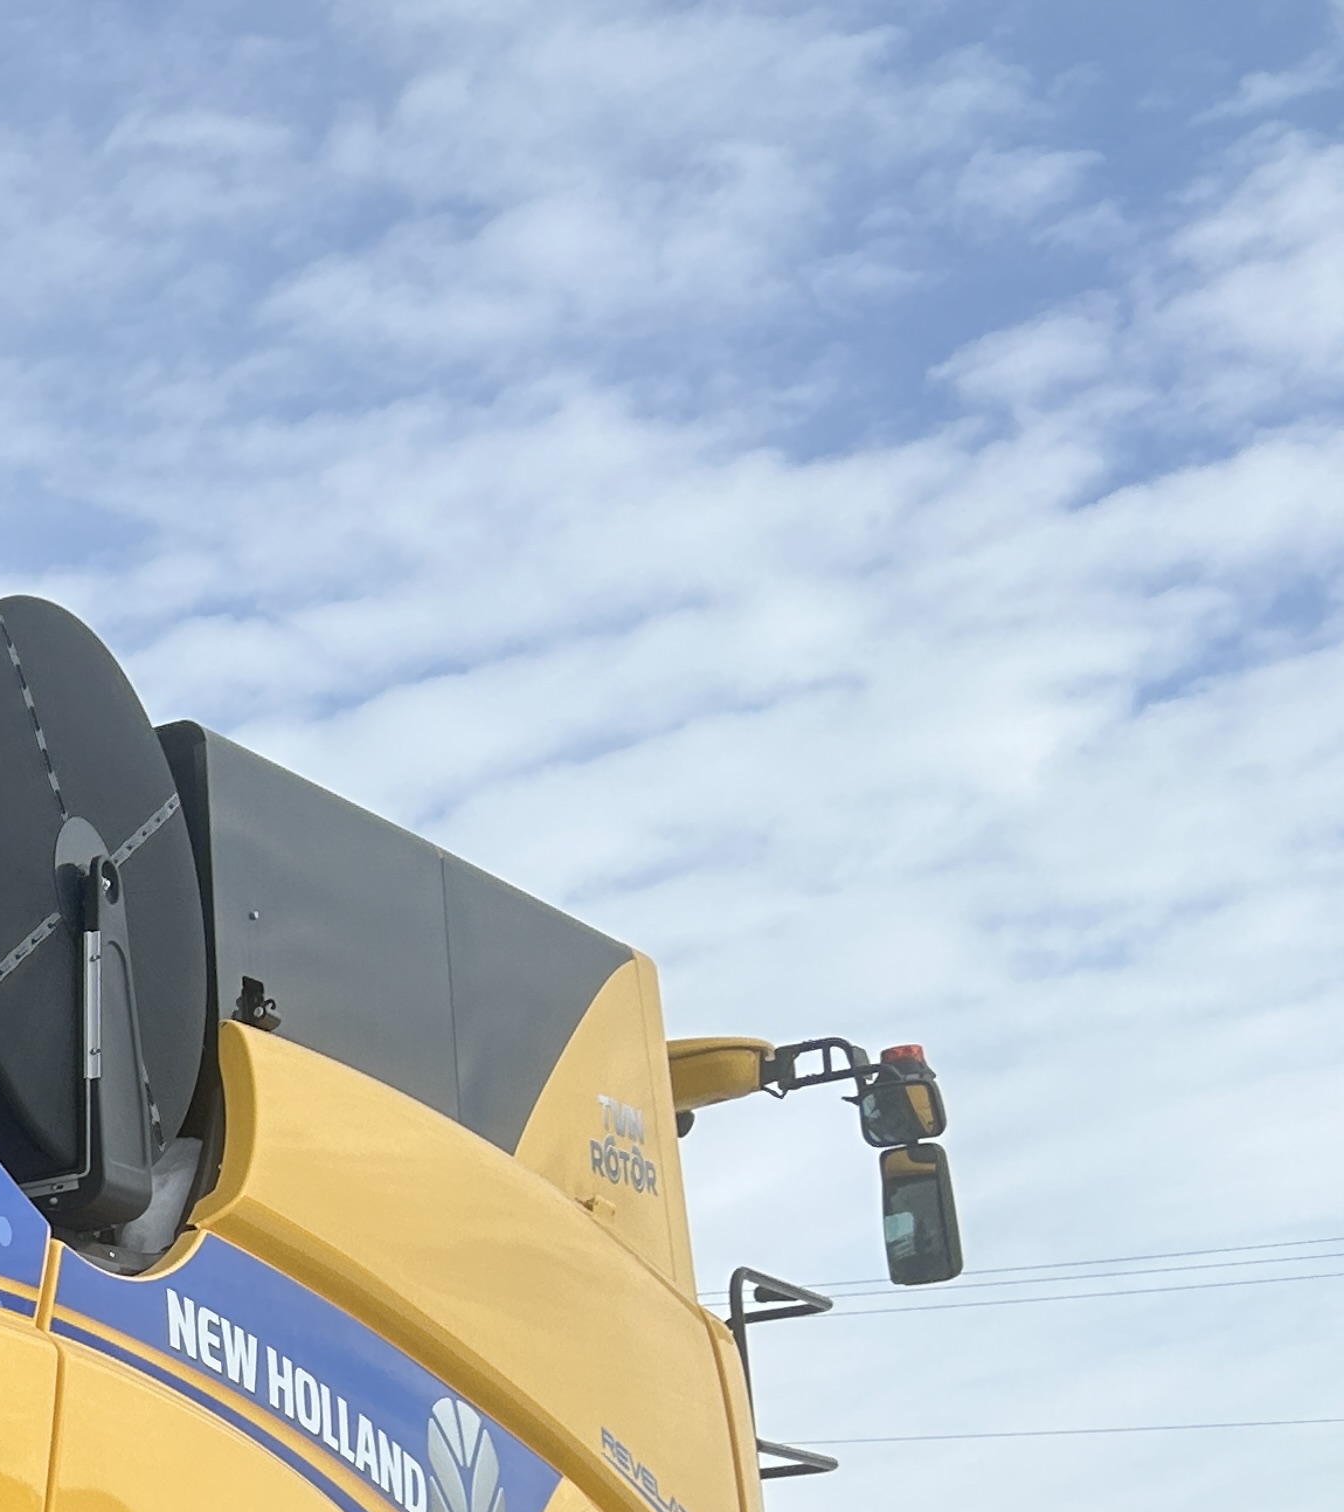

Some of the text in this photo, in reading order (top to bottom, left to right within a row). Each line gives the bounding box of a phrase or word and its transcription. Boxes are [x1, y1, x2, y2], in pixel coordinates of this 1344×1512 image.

[596, 1094, 645, 1145] TWIN
[589, 1134, 658, 1196] ROTOR
[166, 1288, 258, 1394] NEW
